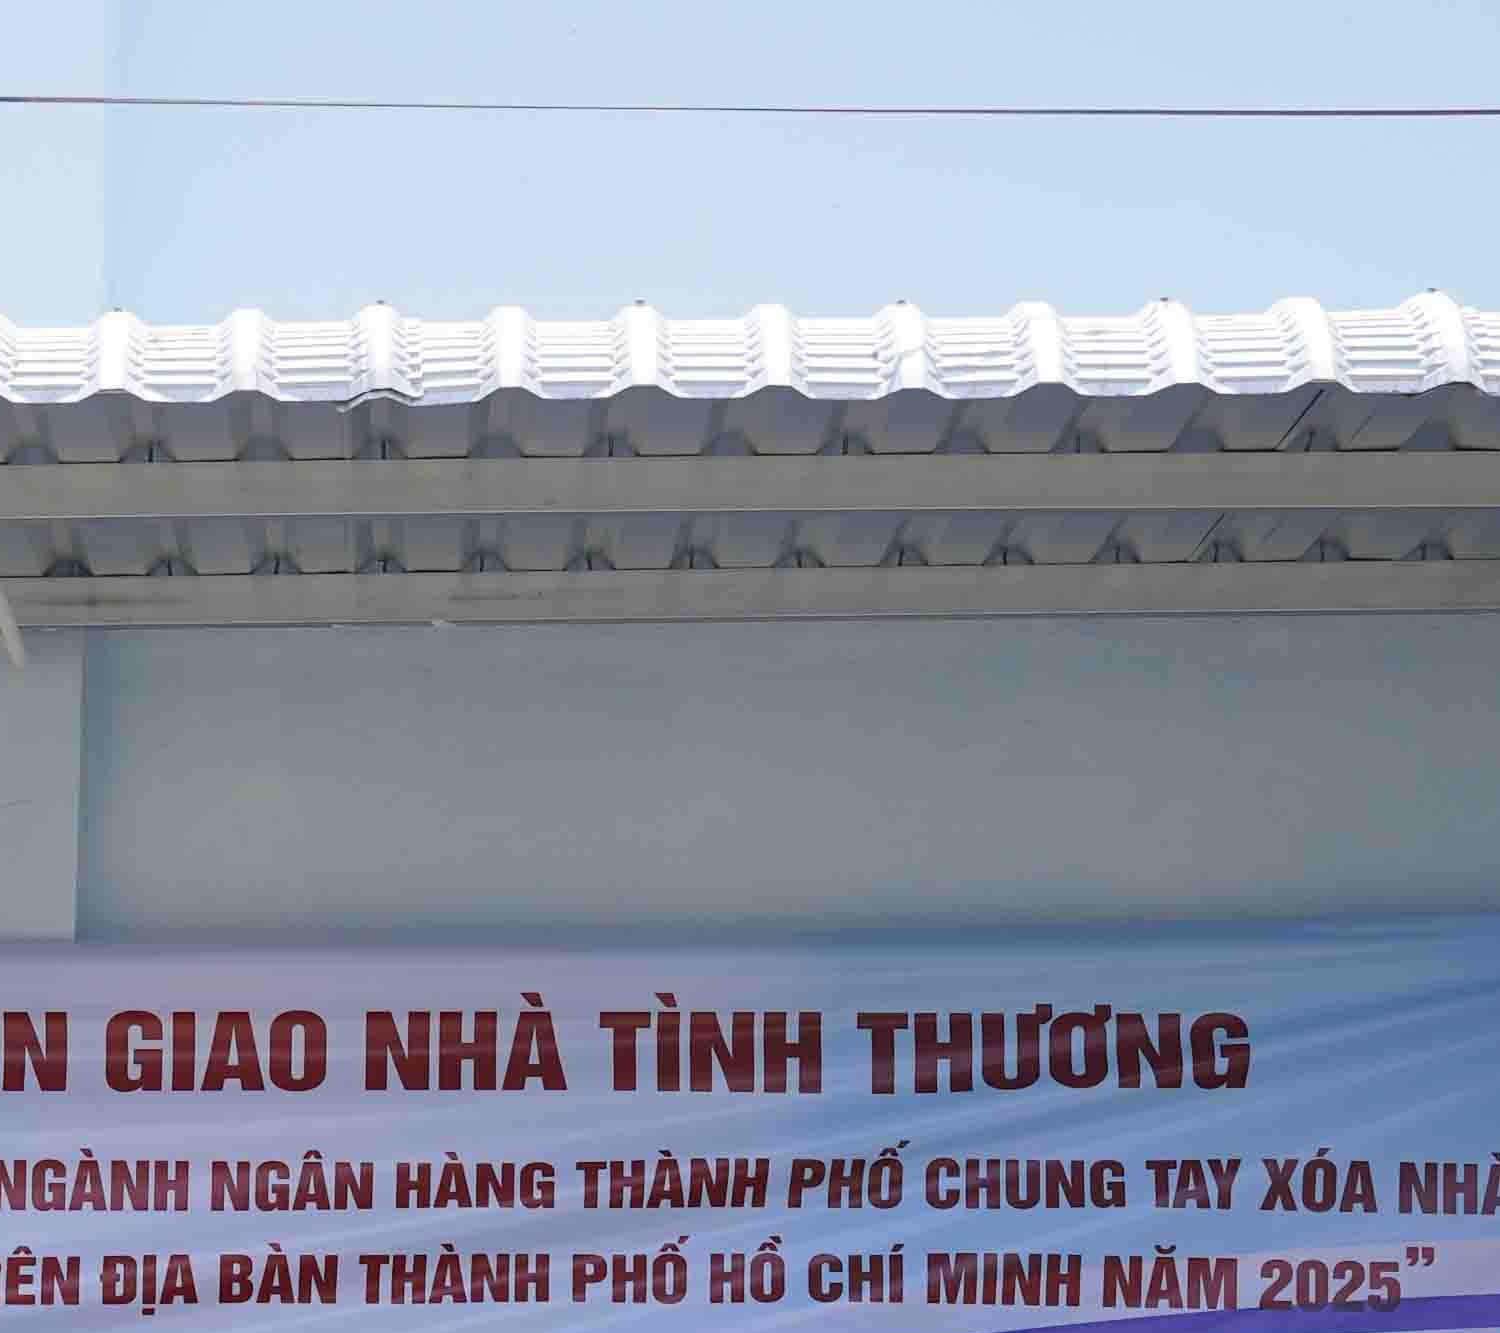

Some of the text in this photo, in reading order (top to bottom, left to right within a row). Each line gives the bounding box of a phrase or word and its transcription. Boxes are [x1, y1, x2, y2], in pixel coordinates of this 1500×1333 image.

[105, 1010, 326, 1093] GIAO
[365, 992, 567, 1092] NHÀ
[600, 992, 822, 1094] TÌNH
[856, 1002, 1250, 1094] THƯƠNG
[210, 1147, 374, 1212] NGÂN
[395, 1151, 556, 1209] HÀNG
[576, 1149, 769, 1209] THÀNH
[788, 1139, 910, 1209] PHỐ
[925, 1158, 1127, 1210] CHUNG
[1145, 1158, 1241, 1211] TAY
[1261, 1147, 1376, 1215] XÓA
[101, 1253, 197, 1318] ĐỊA
[218, 1241, 339, 1305] BÀN
[359, 1243, 550, 1305] THÀNH
[572, 1235, 688, 1305] PHỐ
[710, 1235, 785, 1305] HỒ
[808, 1243, 903, 1305] CHÍ
[927, 1252, 1082, 1308] MINH
[1103, 1245, 1238, 1311] NĂM
[1260, 1245, 1434, 1314] 2025”
